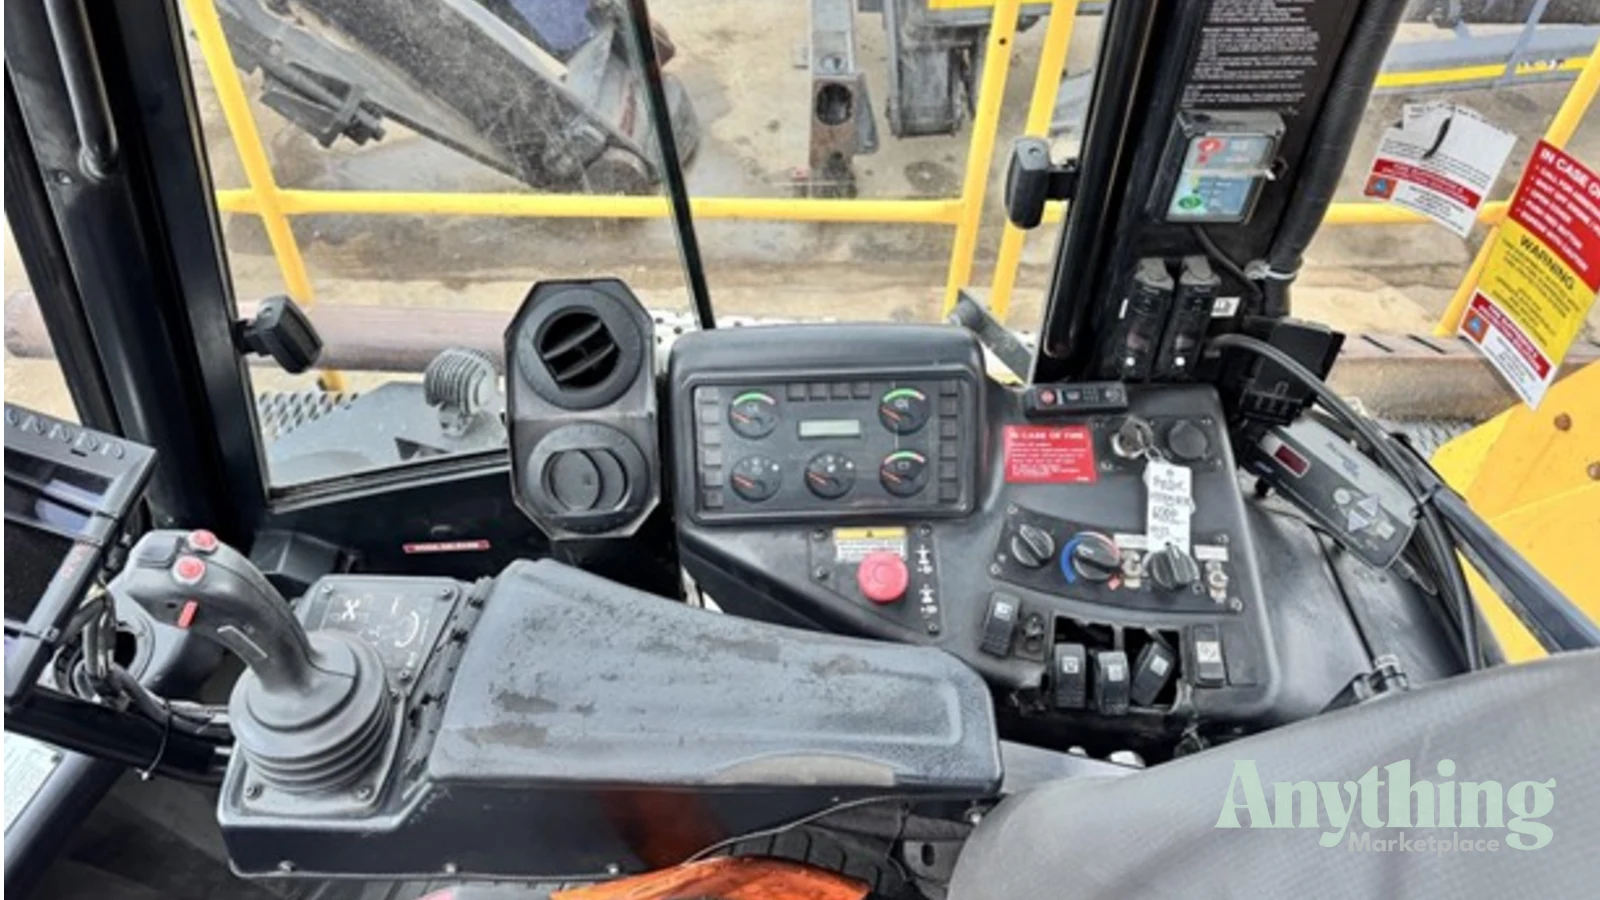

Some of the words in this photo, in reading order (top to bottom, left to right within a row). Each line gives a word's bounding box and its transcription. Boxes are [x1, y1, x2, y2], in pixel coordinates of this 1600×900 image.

[1540, 147, 1555, 164] IN
[1556, 157, 1588, 188] CASE
[1587, 181, 1600, 199] O
[1520, 234, 1575, 291] WARNING
